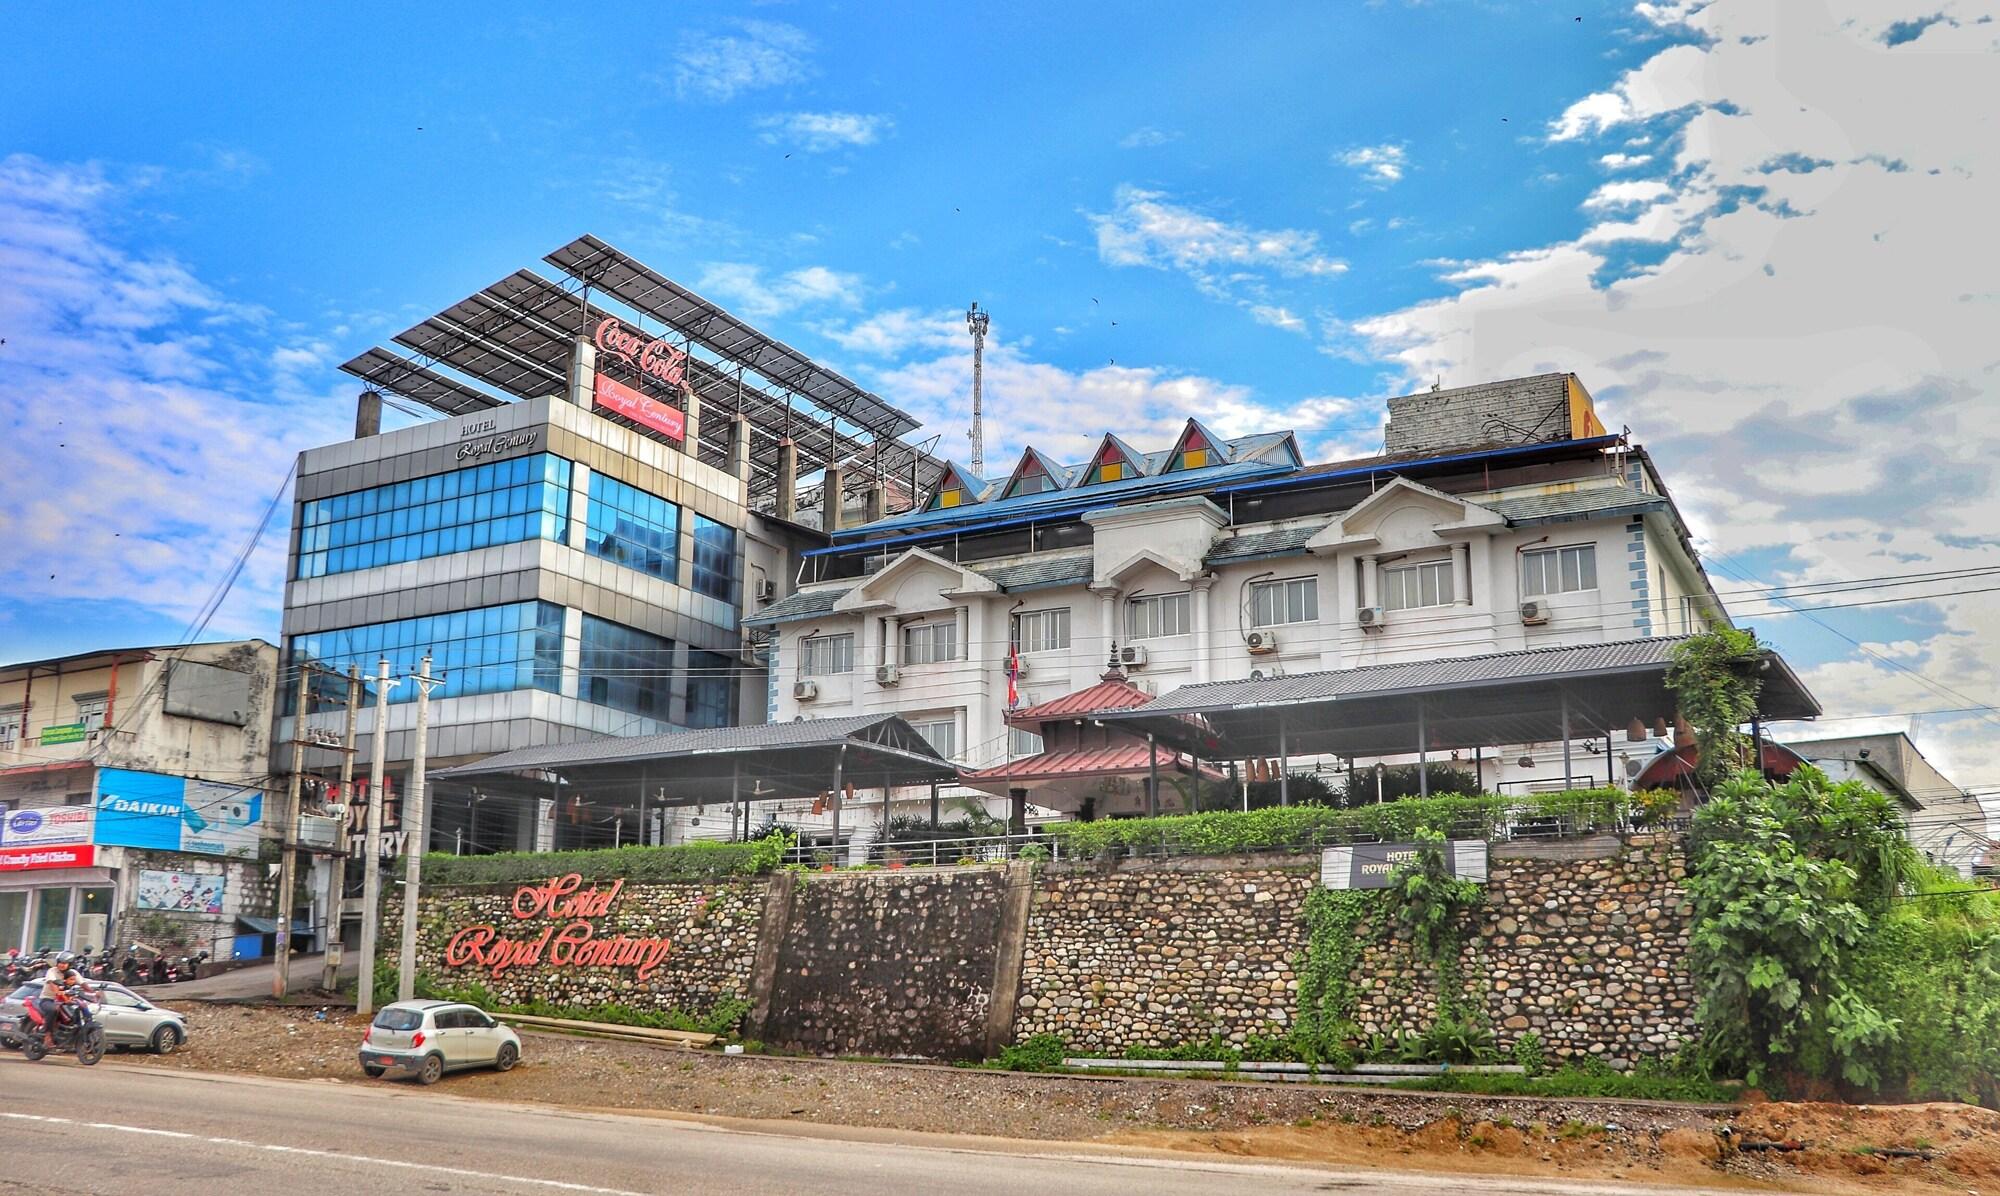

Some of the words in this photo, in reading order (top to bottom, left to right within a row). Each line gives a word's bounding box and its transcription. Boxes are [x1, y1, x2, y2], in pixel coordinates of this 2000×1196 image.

[601, 381, 641, 411] Royal
[461, 419, 496, 436] HOTEL
[455, 437, 495, 460] Royal
[493, 431, 538, 454] Century
[114, 800, 180, 817] DAIKIN
[512, 873, 625, 919] Hotel
[446, 925, 553, 978] Royal
[551, 919, 671, 981] Century
